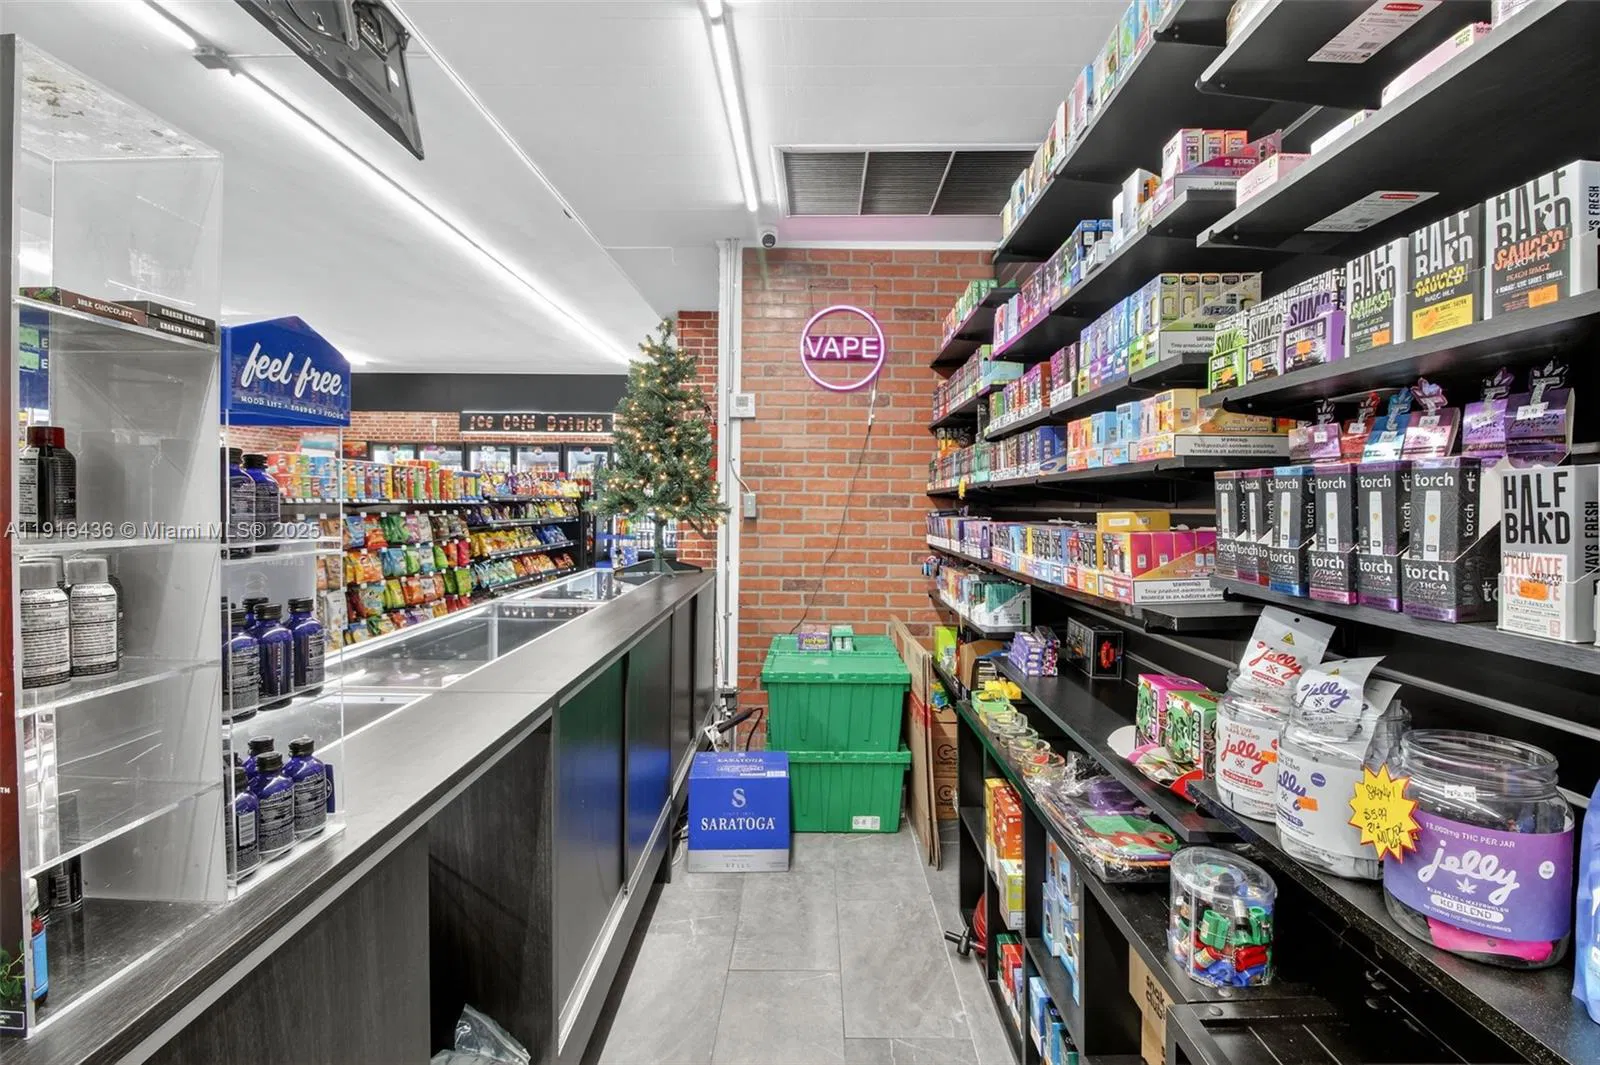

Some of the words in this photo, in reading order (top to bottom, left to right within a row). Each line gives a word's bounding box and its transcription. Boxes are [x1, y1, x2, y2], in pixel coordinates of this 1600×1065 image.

[1496, 170, 1566, 221] HALF
[1415, 210, 1469, 253] HALF
[1353, 244, 1393, 279] HALF
[805, 336, 879, 359] VAPE
[241, 341, 294, 388] feel
[294, 356, 343, 399] free
[1275, 478, 1299, 490] torch
[1318, 476, 1347, 490] torch
[1360, 475, 1392, 488] torch
[1414, 472, 1454, 487] torch
[1503, 471, 1569, 510] HALF
[1305, 502, 1315, 528] torch
[1401, 502, 1411, 533] torch
[1463, 503, 1475, 538] torch
[1504, 511, 1571, 545] BAK'D
[1584, 501, 1599, 538] FRESH
[1270, 550, 1296, 564] torch
[1311, 553, 1345, 569] torch
[1359, 558, 1393, 574] torch
[1404, 563, 1450, 582] torch
[1419, 581, 1448, 590] THC-A
[1249, 647, 1303, 680] jelly
[1300, 681, 1350, 709] jelly
[1221, 734, 1269, 775] jelly
[731, 787, 747, 808] S
[701, 816, 776, 831] SARATOGA
[1461, 832, 1479, 842] THC
[1480, 836, 1498, 846] PER
[1499, 839, 1516, 848] JAR
[1418, 839, 1520, 906] jelly
